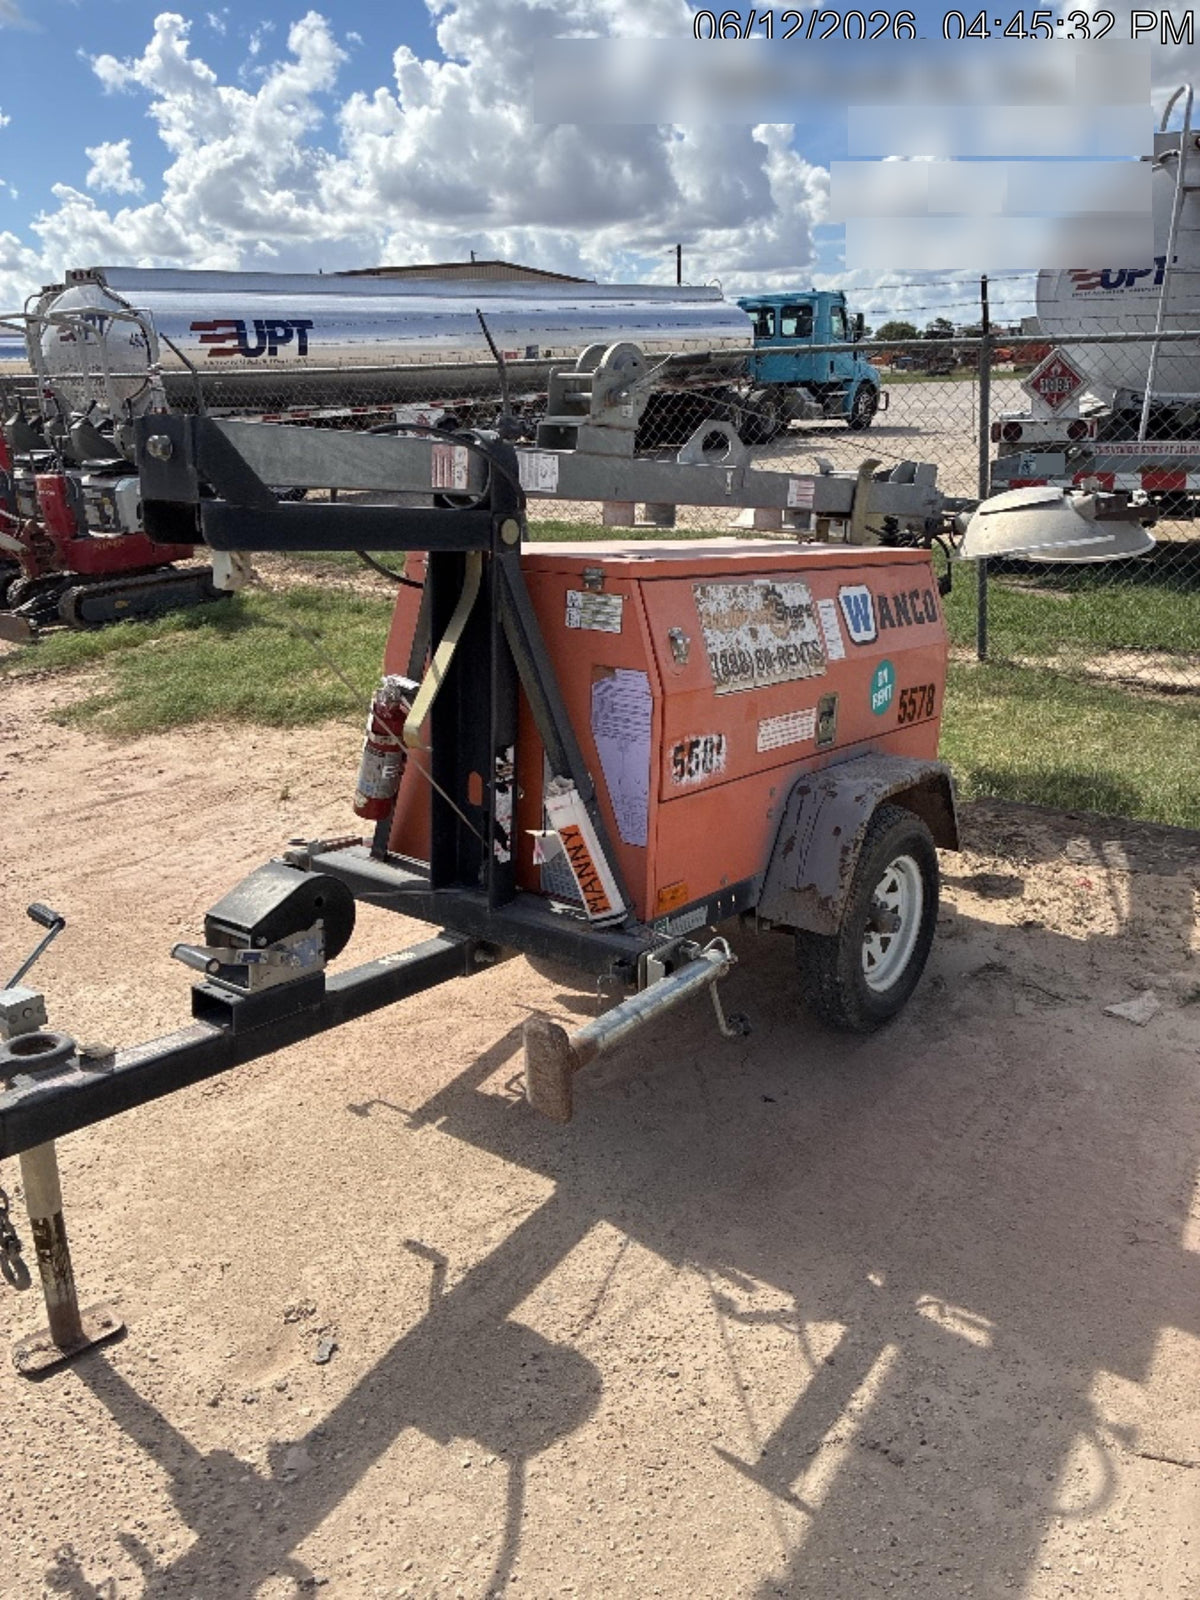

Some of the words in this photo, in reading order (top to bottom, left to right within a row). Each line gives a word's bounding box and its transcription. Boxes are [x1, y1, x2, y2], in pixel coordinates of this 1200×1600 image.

[236, 319, 315, 358] UPT
[842, 589, 938, 634] WANCO
[872, 684, 892, 710] RENT
[898, 683, 936, 724] 5578
